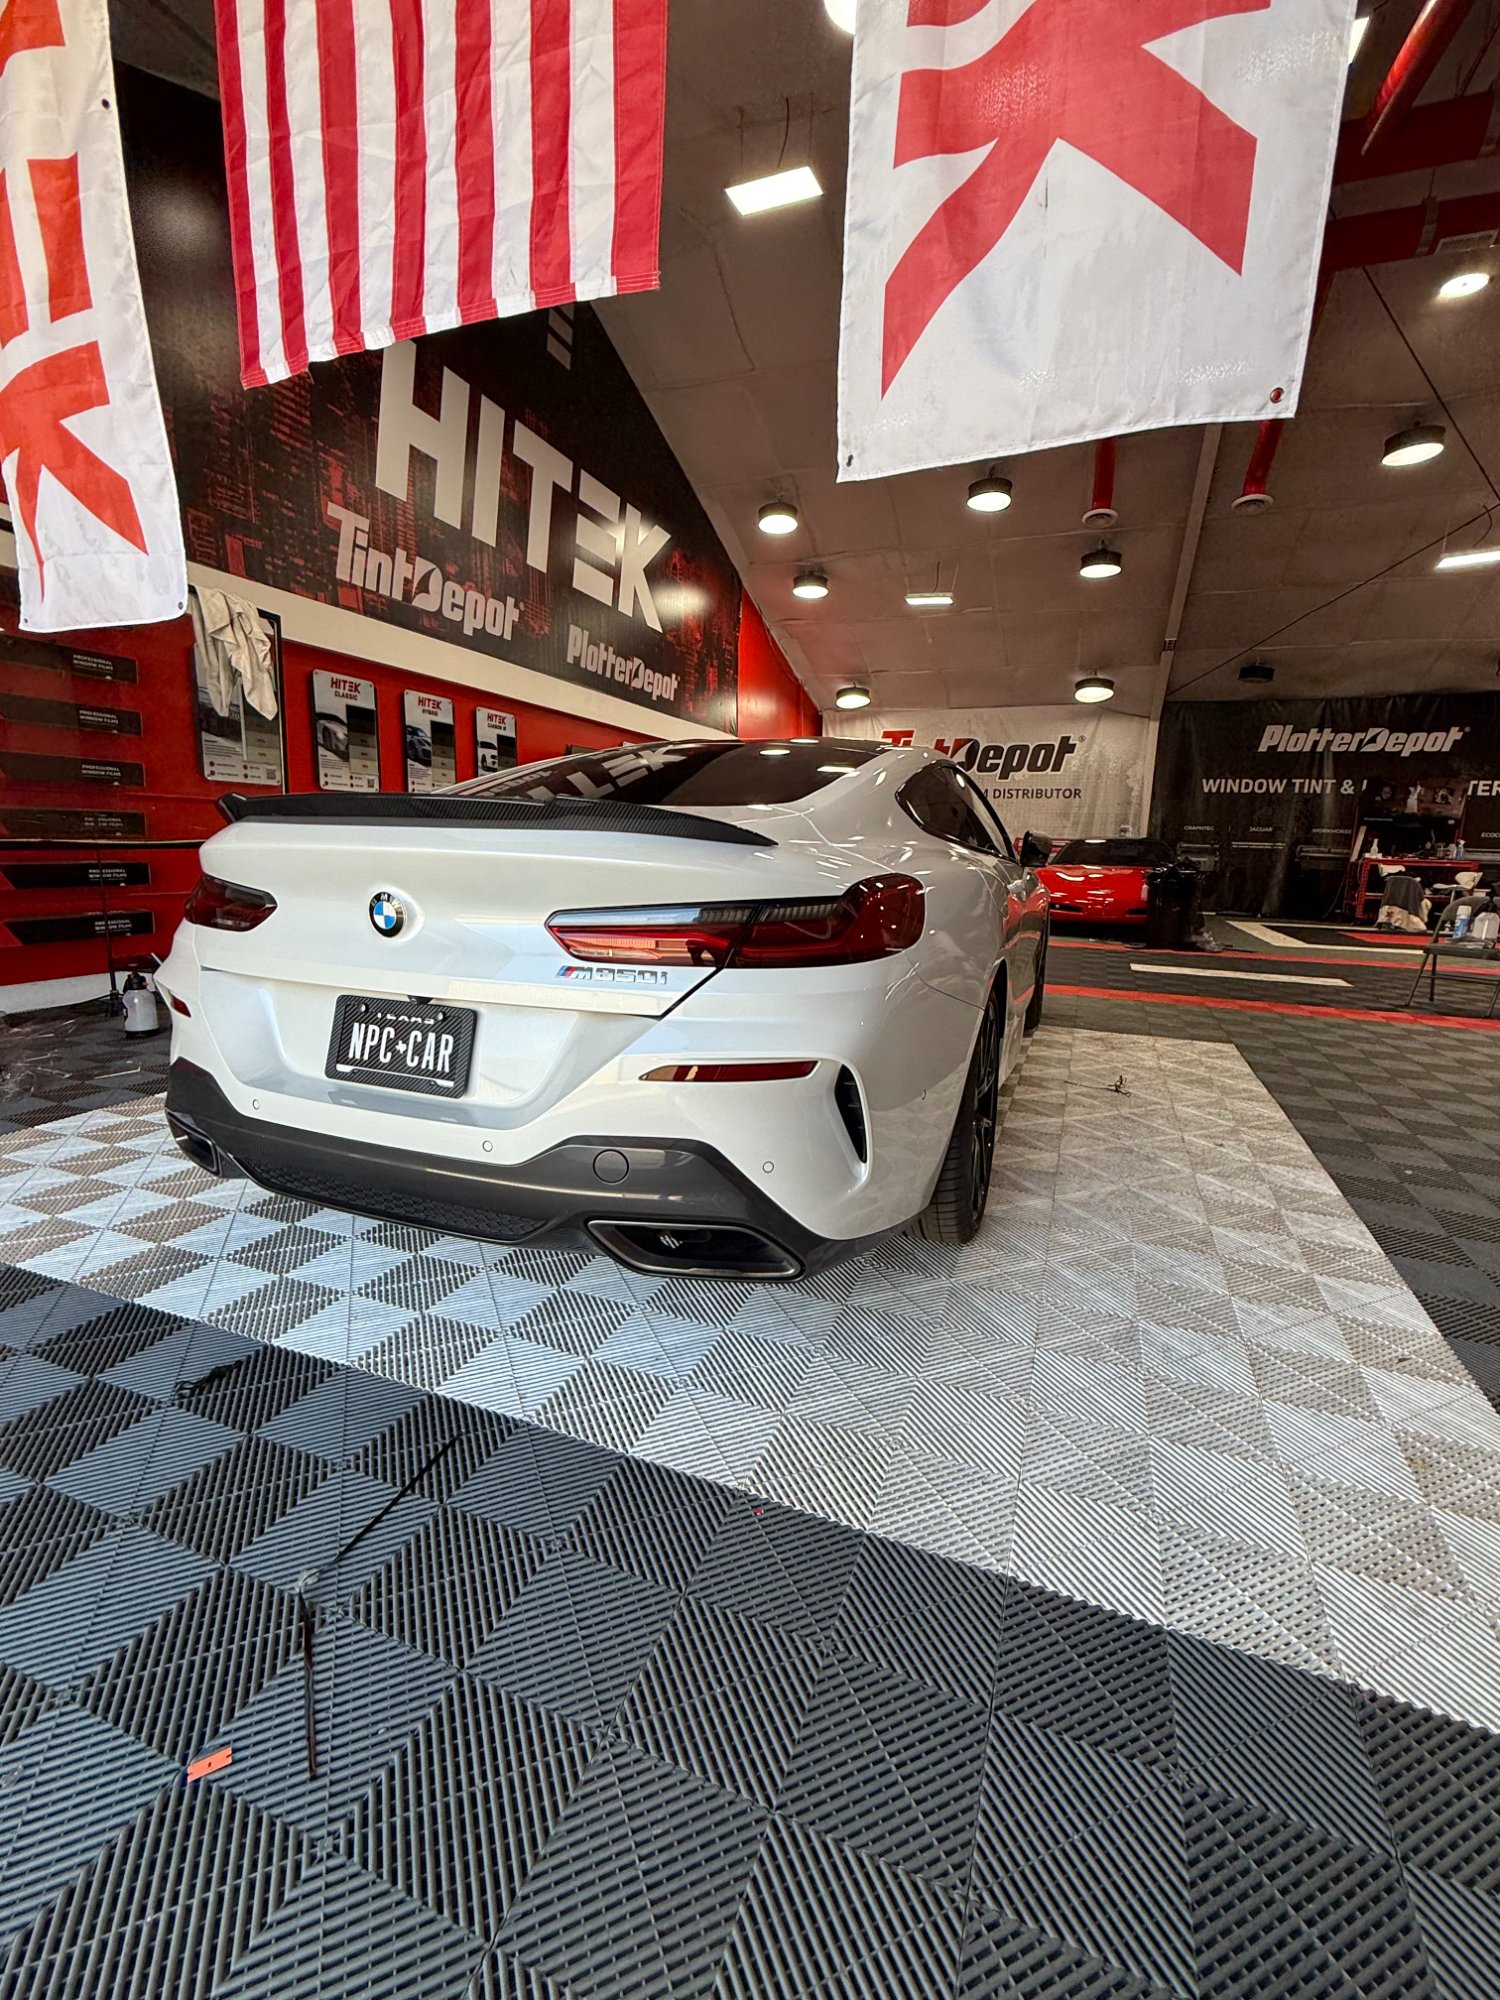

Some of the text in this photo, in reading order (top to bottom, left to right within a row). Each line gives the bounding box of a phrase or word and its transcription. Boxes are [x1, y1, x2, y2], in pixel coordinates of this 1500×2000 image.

[376, 340, 671, 633] HITEK
[326, 502, 520, 641] TintDepot
[567, 624, 679, 700] PlotterDepot
[330, 677, 361, 694] HITEK
[334, 690, 358, 701] CLASSIC
[417, 696, 442, 712] HITEK
[486, 712, 507, 726] HITEK
[1257, 724, 1463, 757] PlotterDepot
[992, 787, 1082, 800] DISTRIBUTOR
[1202, 778, 1287, 794] WINDOW
[1291, 779, 1336, 795] TINT
[1340, 779, 1355, 795] &
